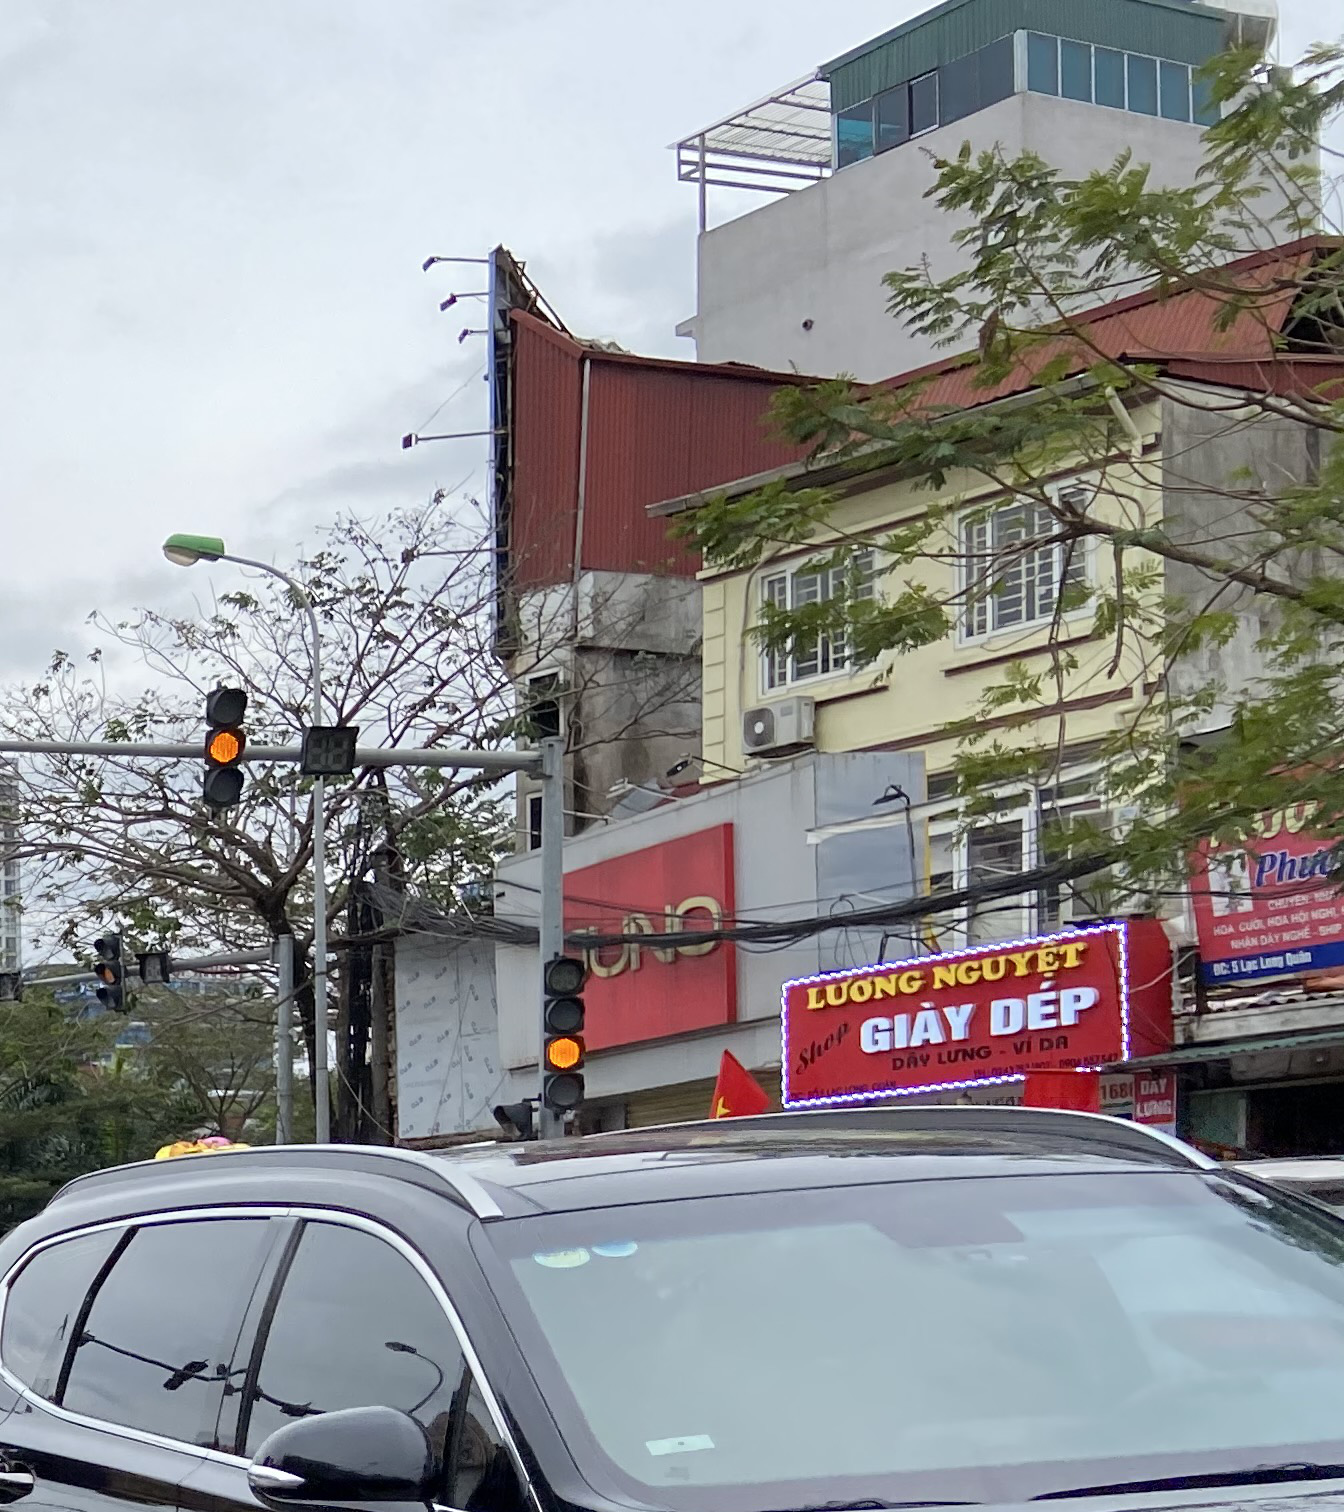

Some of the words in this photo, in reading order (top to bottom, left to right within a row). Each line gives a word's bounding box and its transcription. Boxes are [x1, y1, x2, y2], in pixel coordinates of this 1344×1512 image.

[932, 941, 1088, 990] NGUYỆT
[860, 1001, 976, 1055] GIÀY
[990, 979, 1100, 1037] DÉP
[796, 1022, 850, 1076] Shop
[891, 1052, 930, 1072] DÂY
[937, 1045, 992, 1065] LƯNG
[1013, 1036, 1033, 1054] VÍ
[1039, 1036, 1069, 1052] DA
